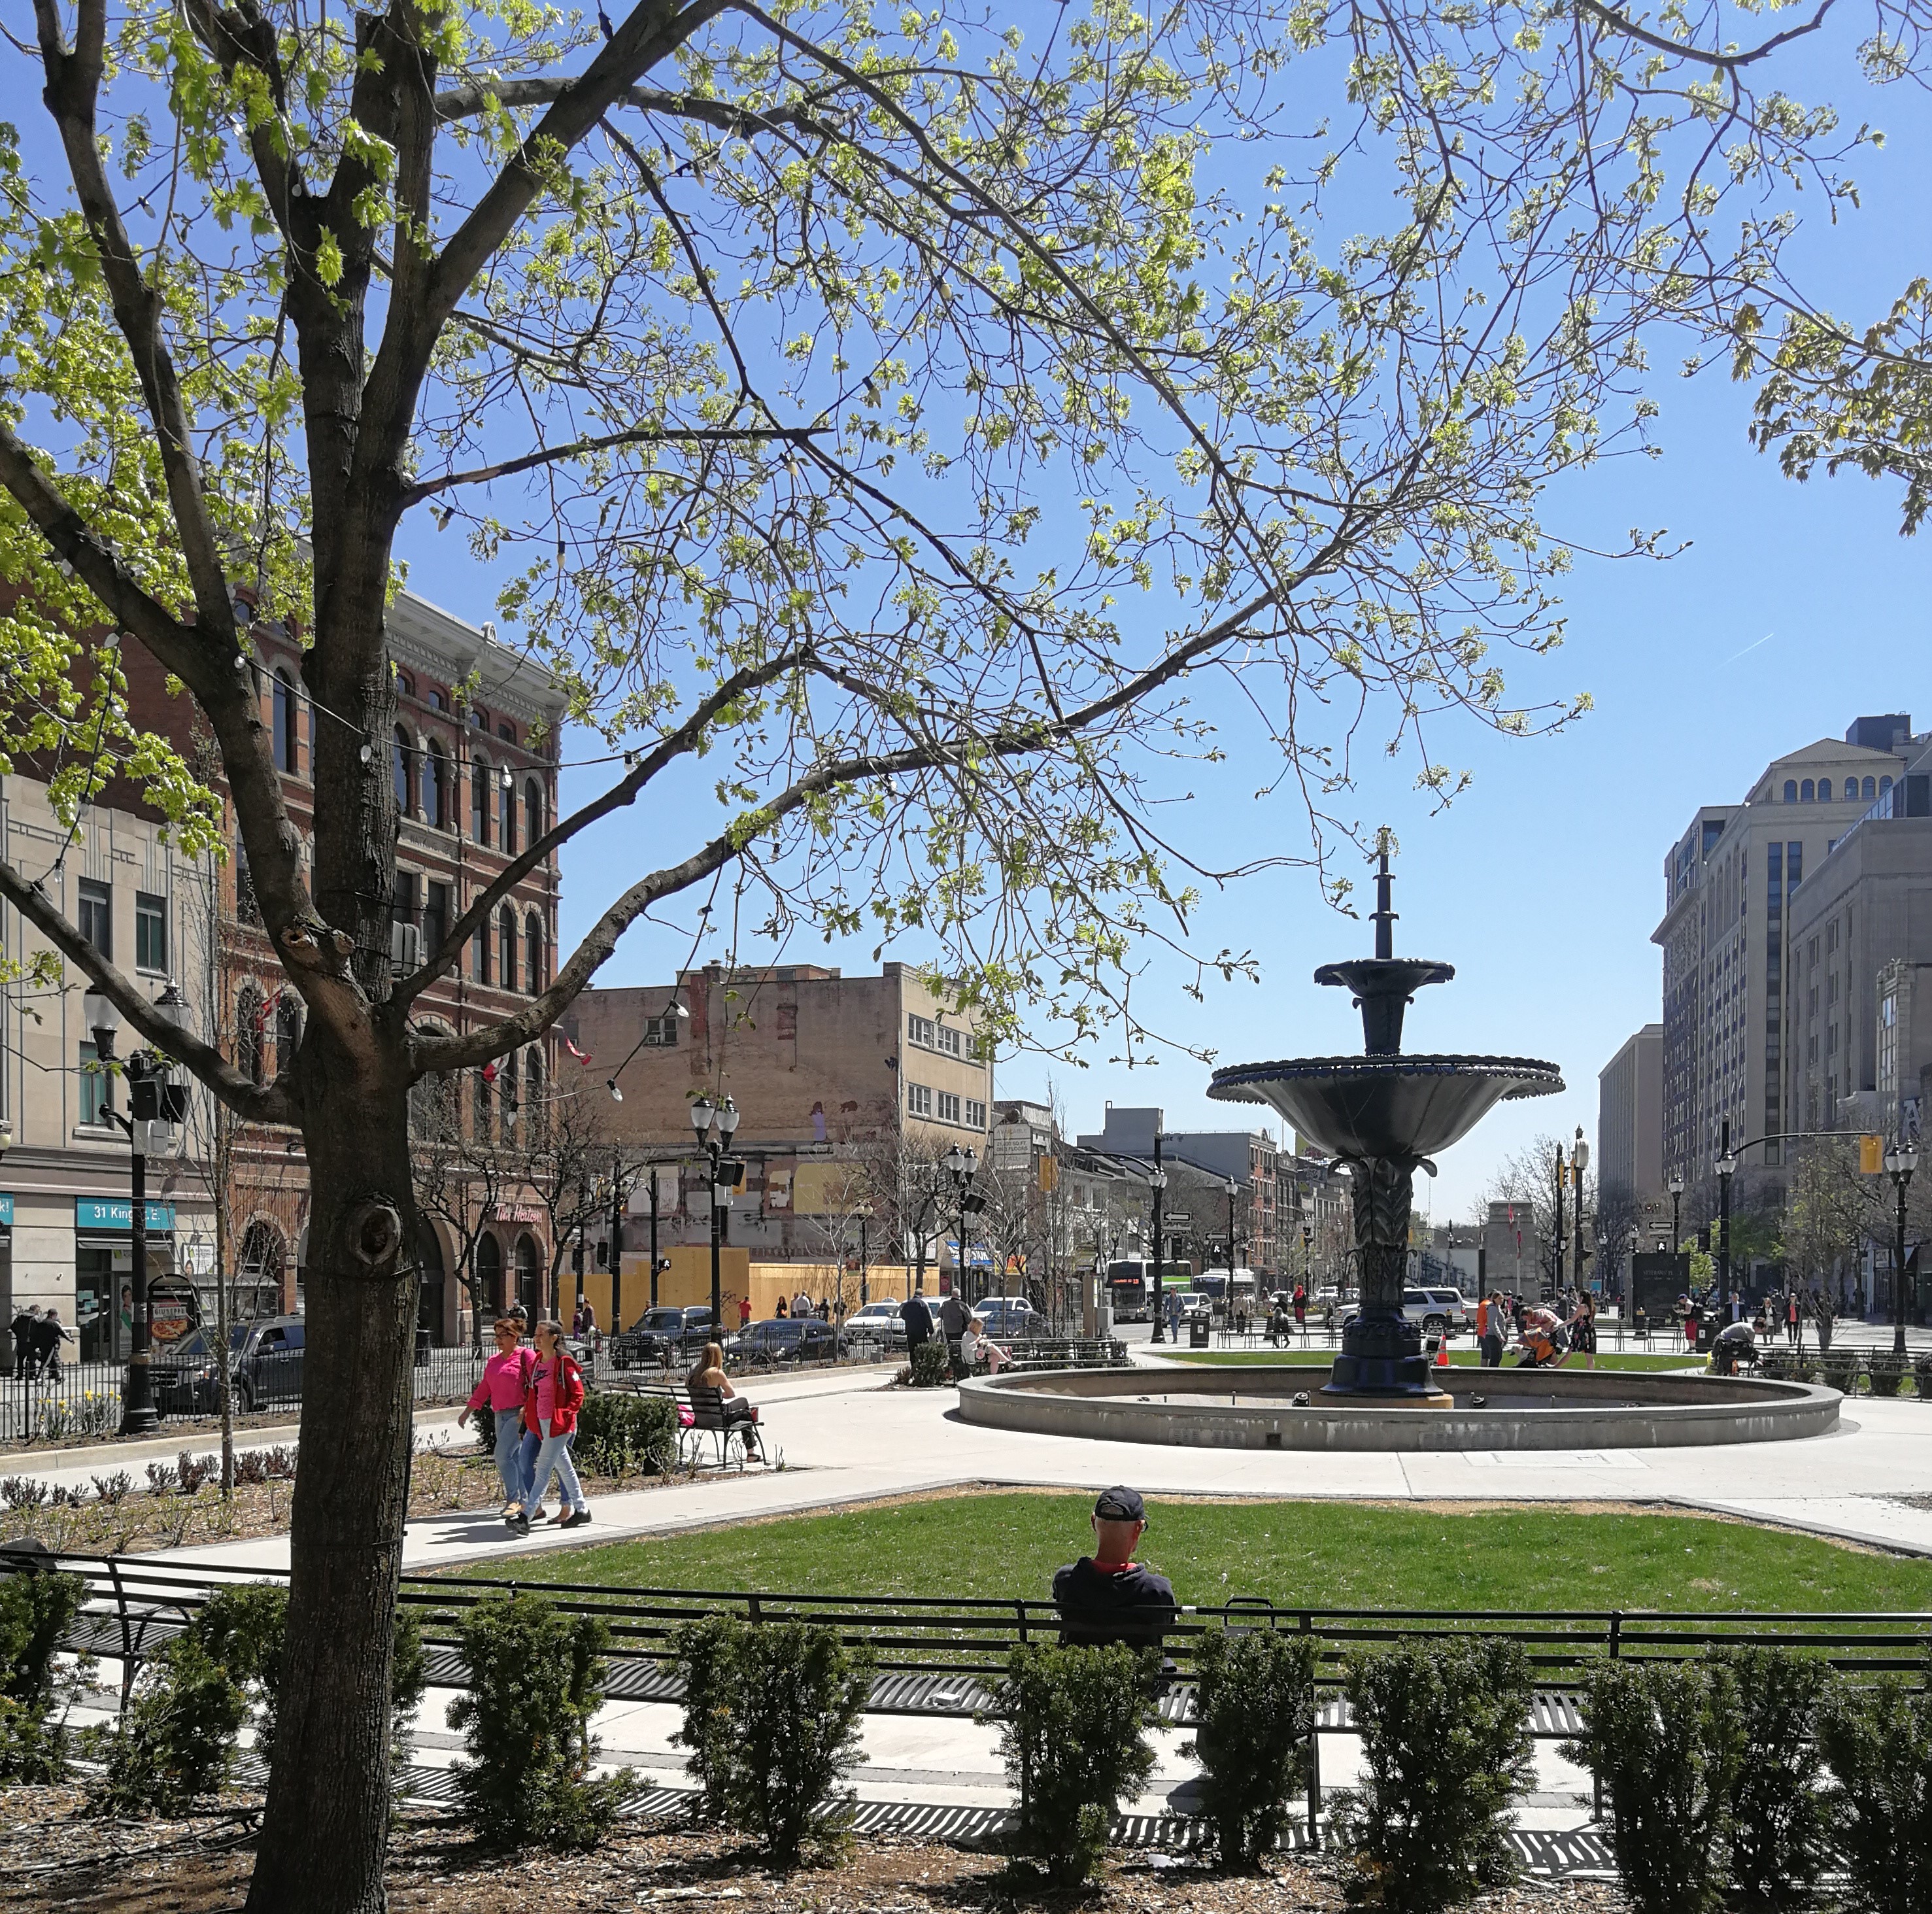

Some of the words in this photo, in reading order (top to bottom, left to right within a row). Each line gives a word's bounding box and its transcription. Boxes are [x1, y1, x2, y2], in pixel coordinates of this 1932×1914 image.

[94, 1206, 106, 1218] 31
[111, 1207, 133, 1222] King
[494, 1203, 511, 1222] Tim
[513, 1204, 542, 1223] Hortons
